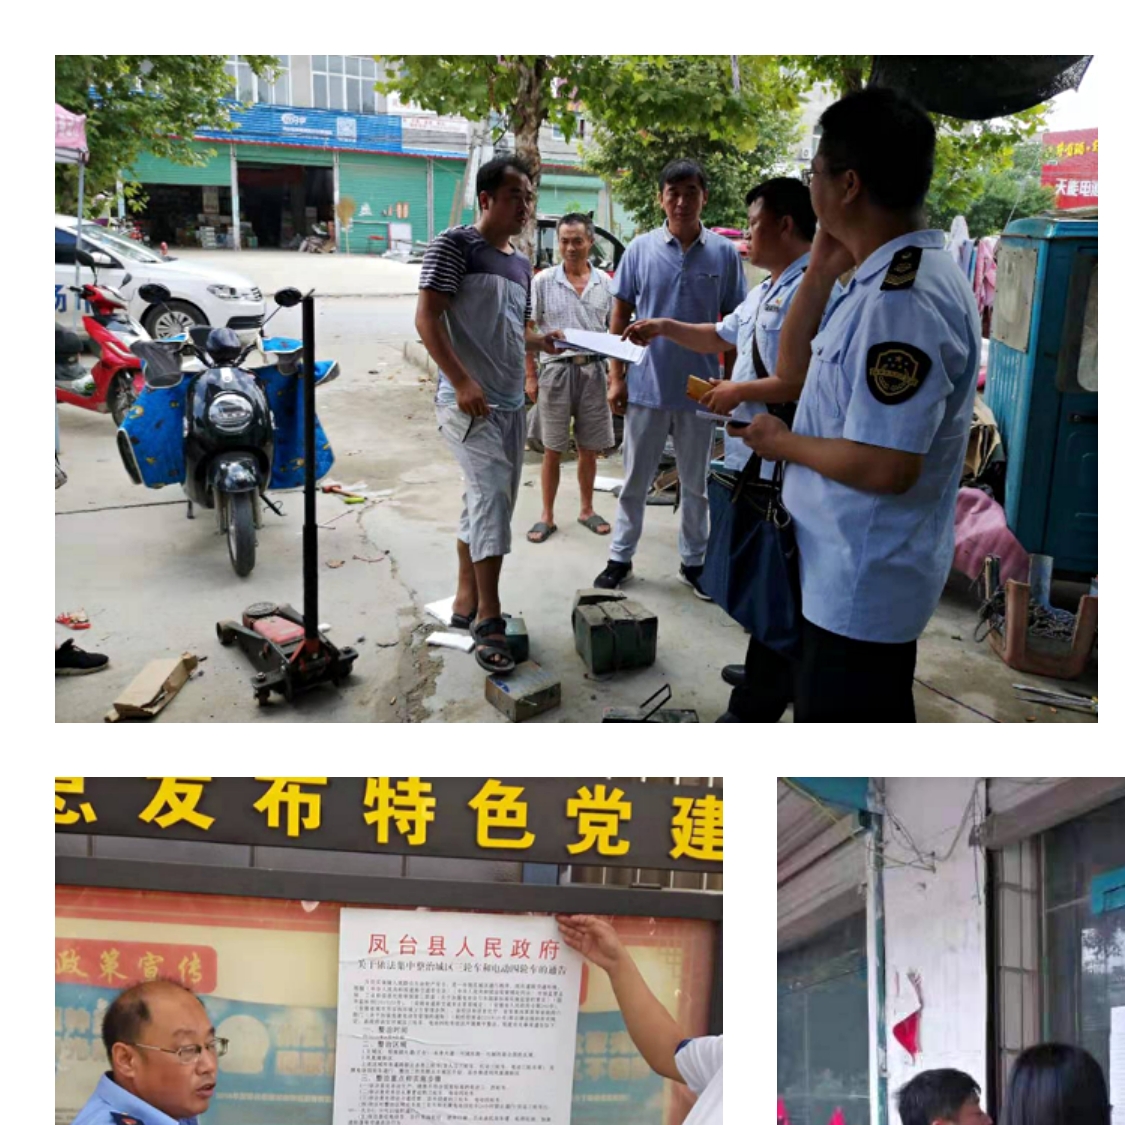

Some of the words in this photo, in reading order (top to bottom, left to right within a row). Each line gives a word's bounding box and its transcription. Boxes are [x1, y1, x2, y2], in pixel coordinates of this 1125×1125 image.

[368, 933, 561, 960] 凤台县人民政府
[56, 948, 203, 984] 政策宣传
